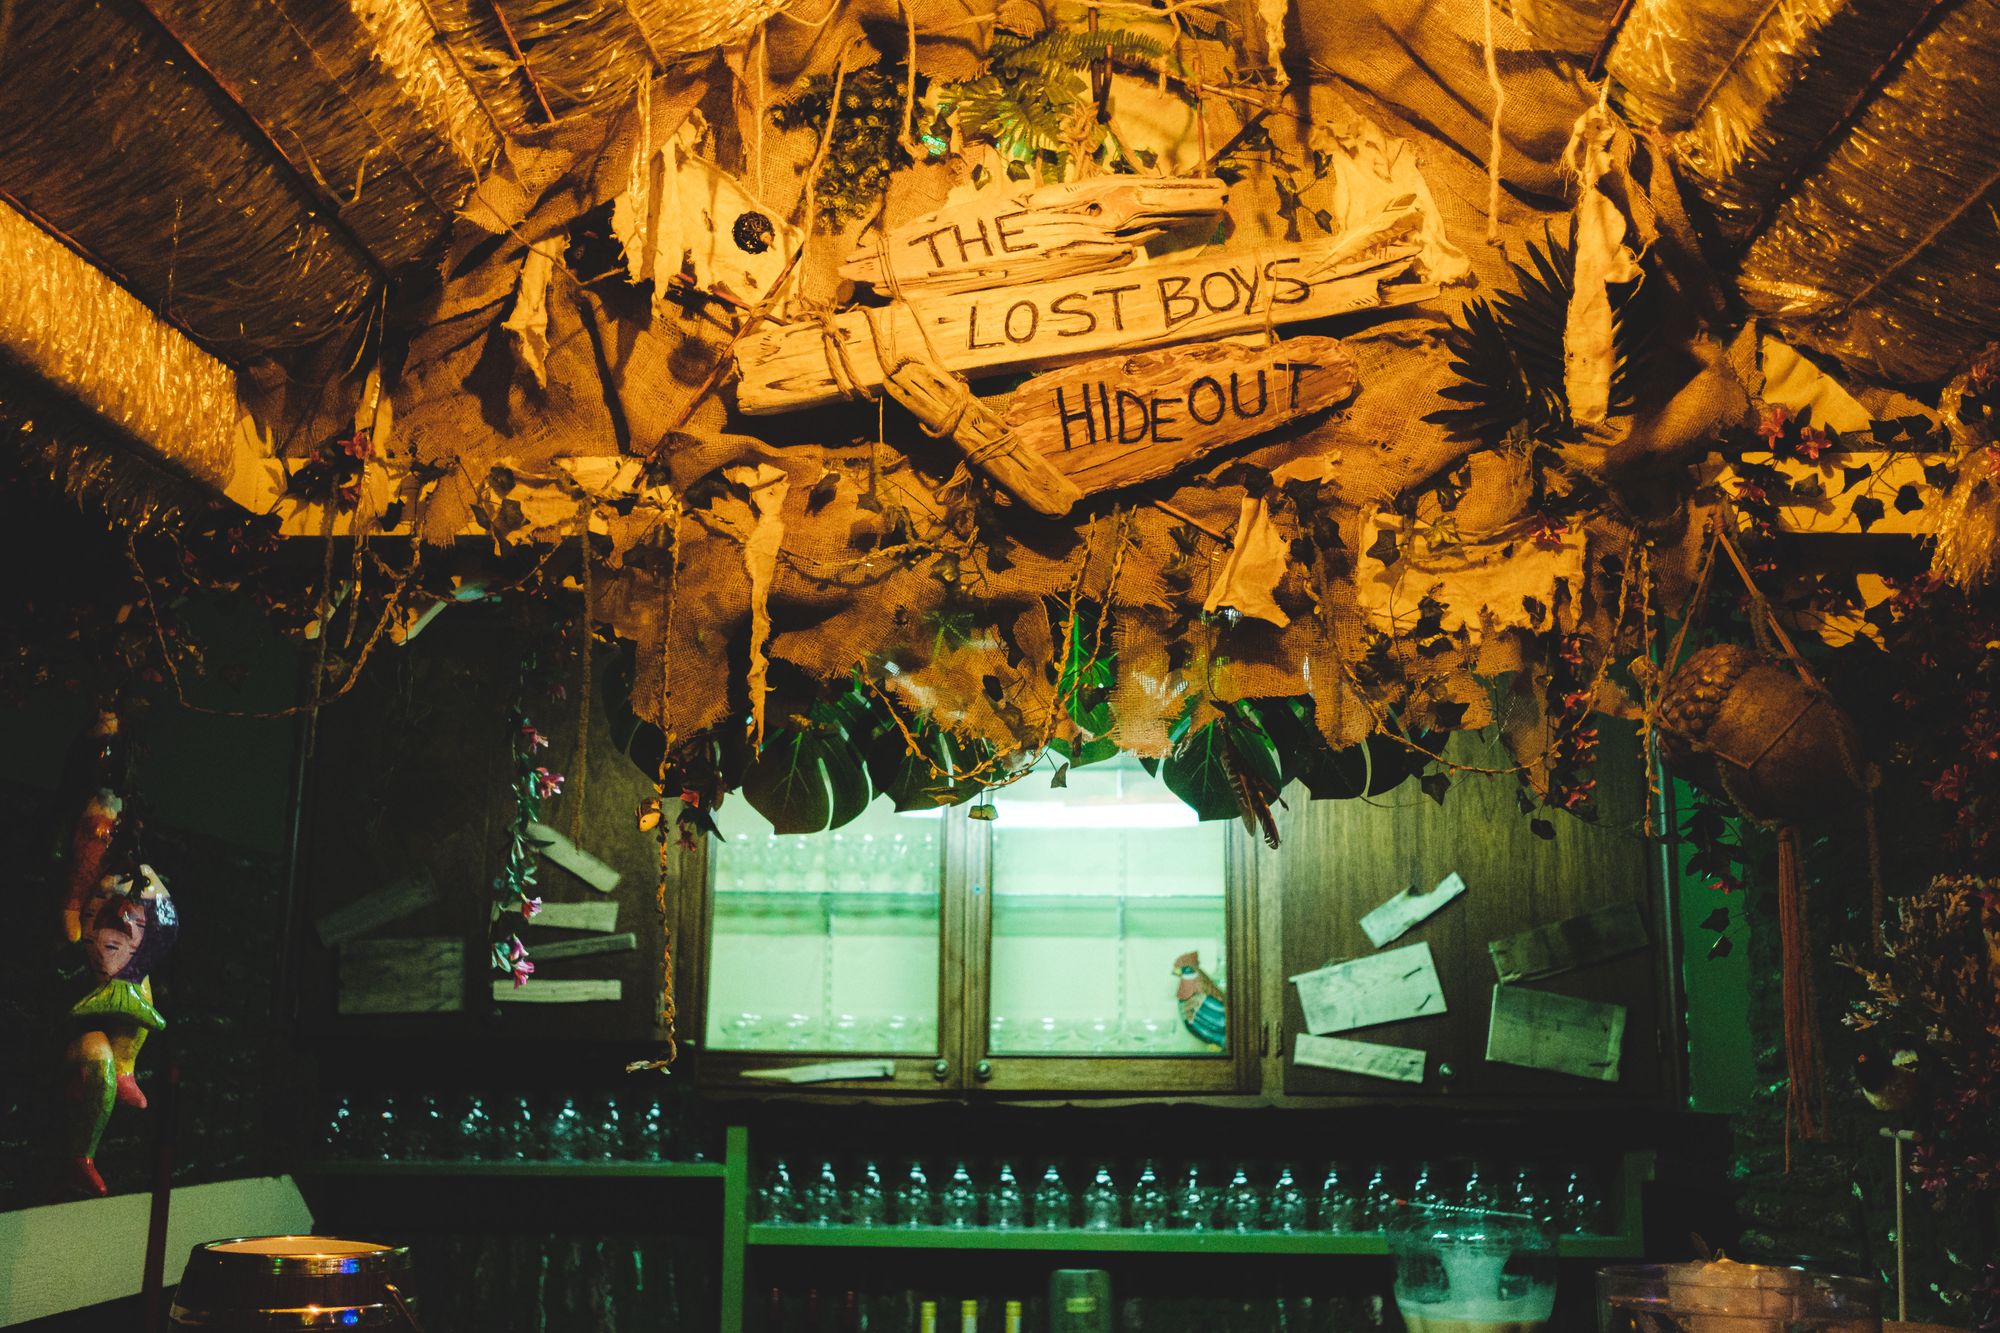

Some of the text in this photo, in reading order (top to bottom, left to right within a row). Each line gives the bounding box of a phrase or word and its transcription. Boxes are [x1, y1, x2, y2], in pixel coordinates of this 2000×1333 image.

[907, 211, 1038, 268] THE
[967, 257, 1311, 350] LOST BOYS
[1055, 363, 1322, 451] HIDEOUT
